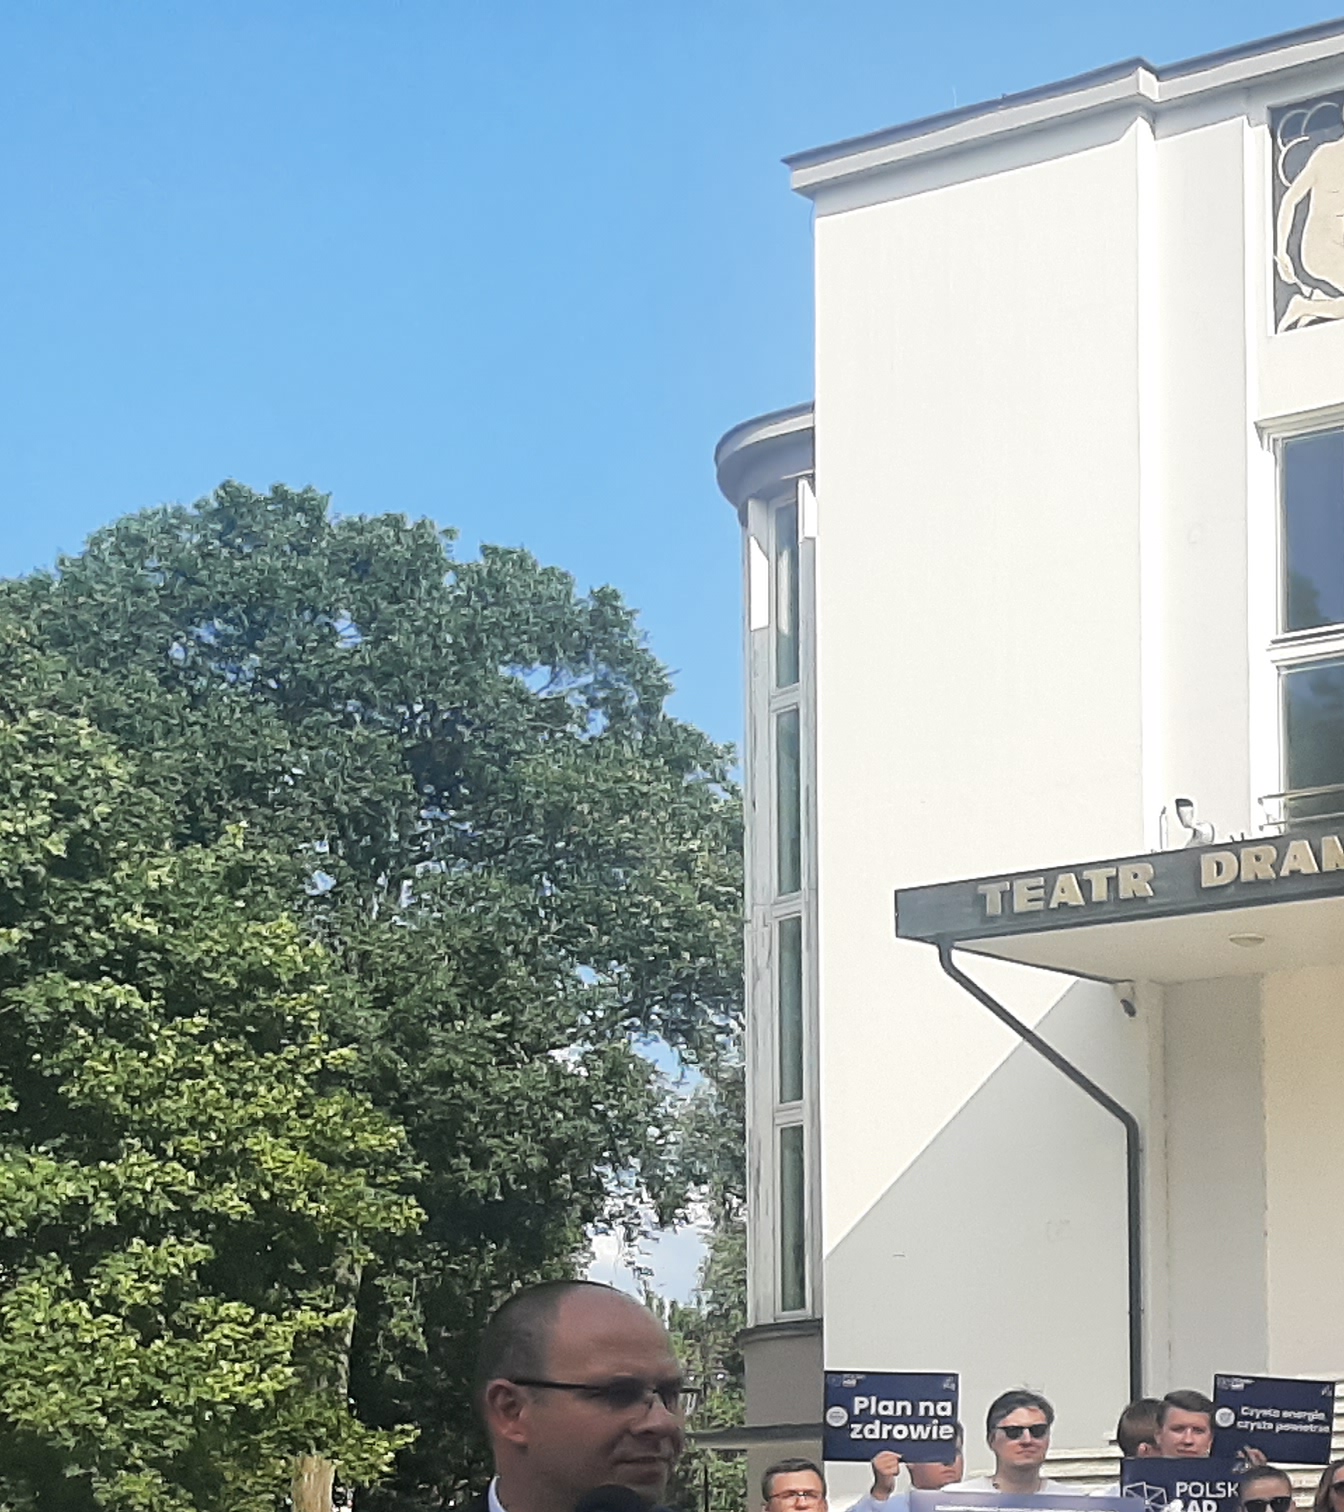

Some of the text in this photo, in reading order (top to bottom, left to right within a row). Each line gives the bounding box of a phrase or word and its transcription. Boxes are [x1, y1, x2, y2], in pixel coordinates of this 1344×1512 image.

[977, 862, 1156, 917] TEATR
[853, 1395, 953, 1417] Plan na
[849, 1419, 955, 1440] zdrowie
[1175, 1481, 1240, 1498] POLSK
